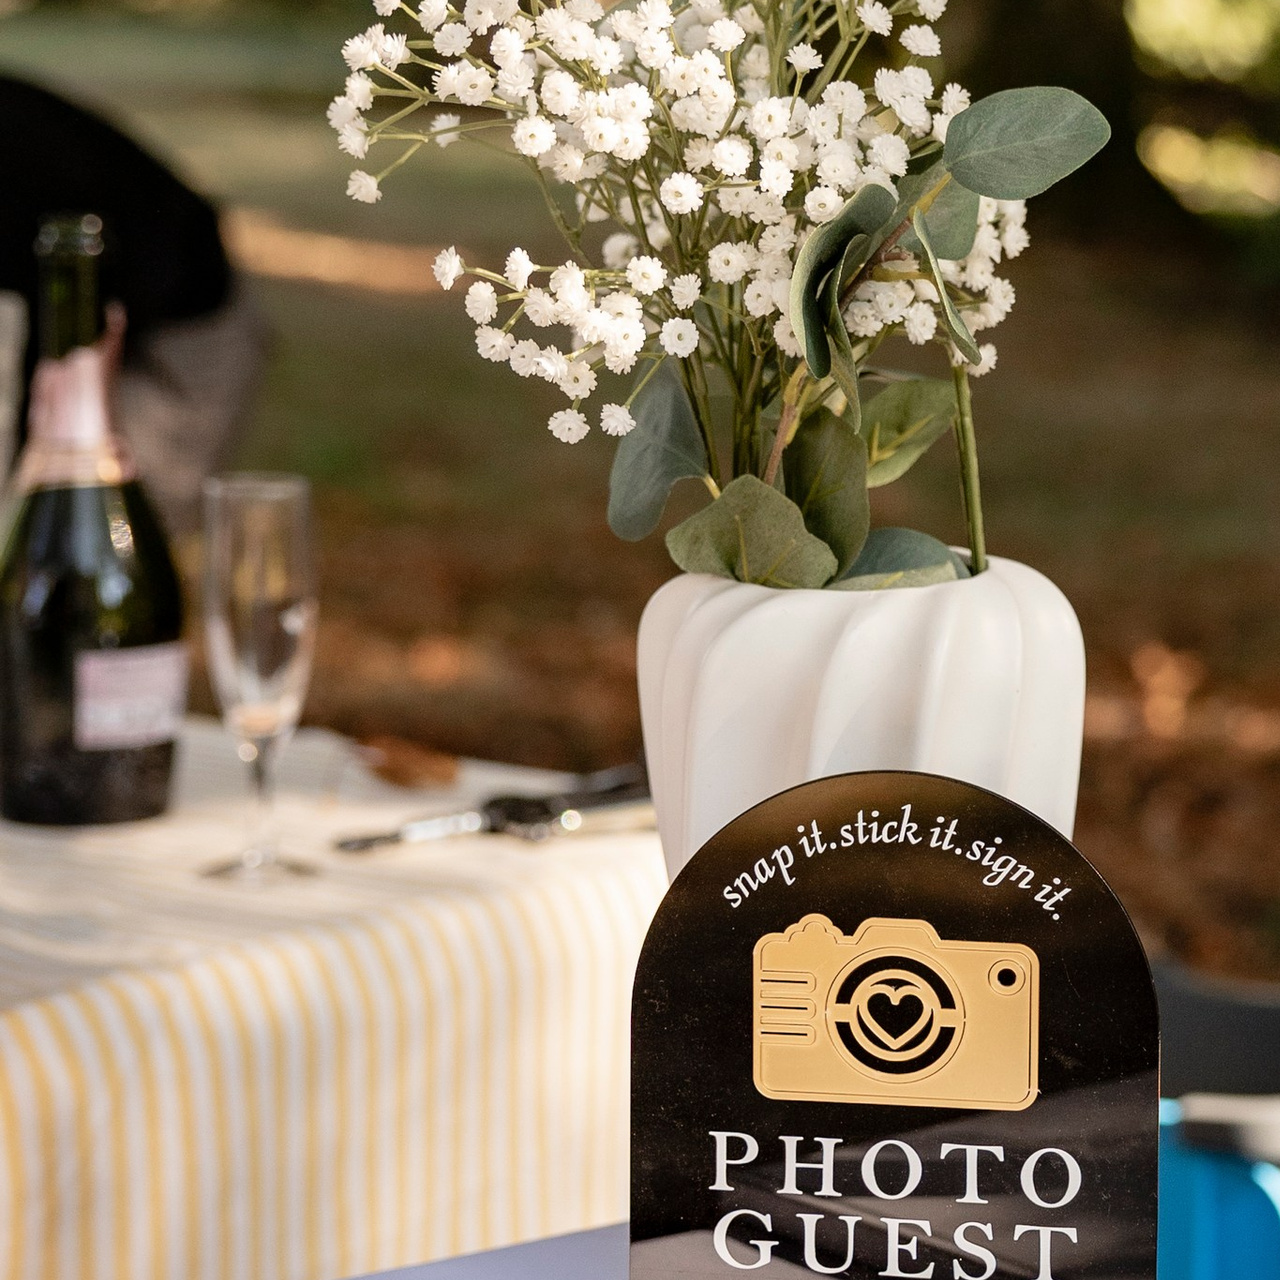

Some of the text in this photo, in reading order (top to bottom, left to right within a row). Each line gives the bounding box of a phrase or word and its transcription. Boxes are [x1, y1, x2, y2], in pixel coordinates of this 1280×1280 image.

[722, 844, 797, 909] snap
[1033, 877, 1073, 921] it.
[708, 1130, 1083, 1209] PHOTO
